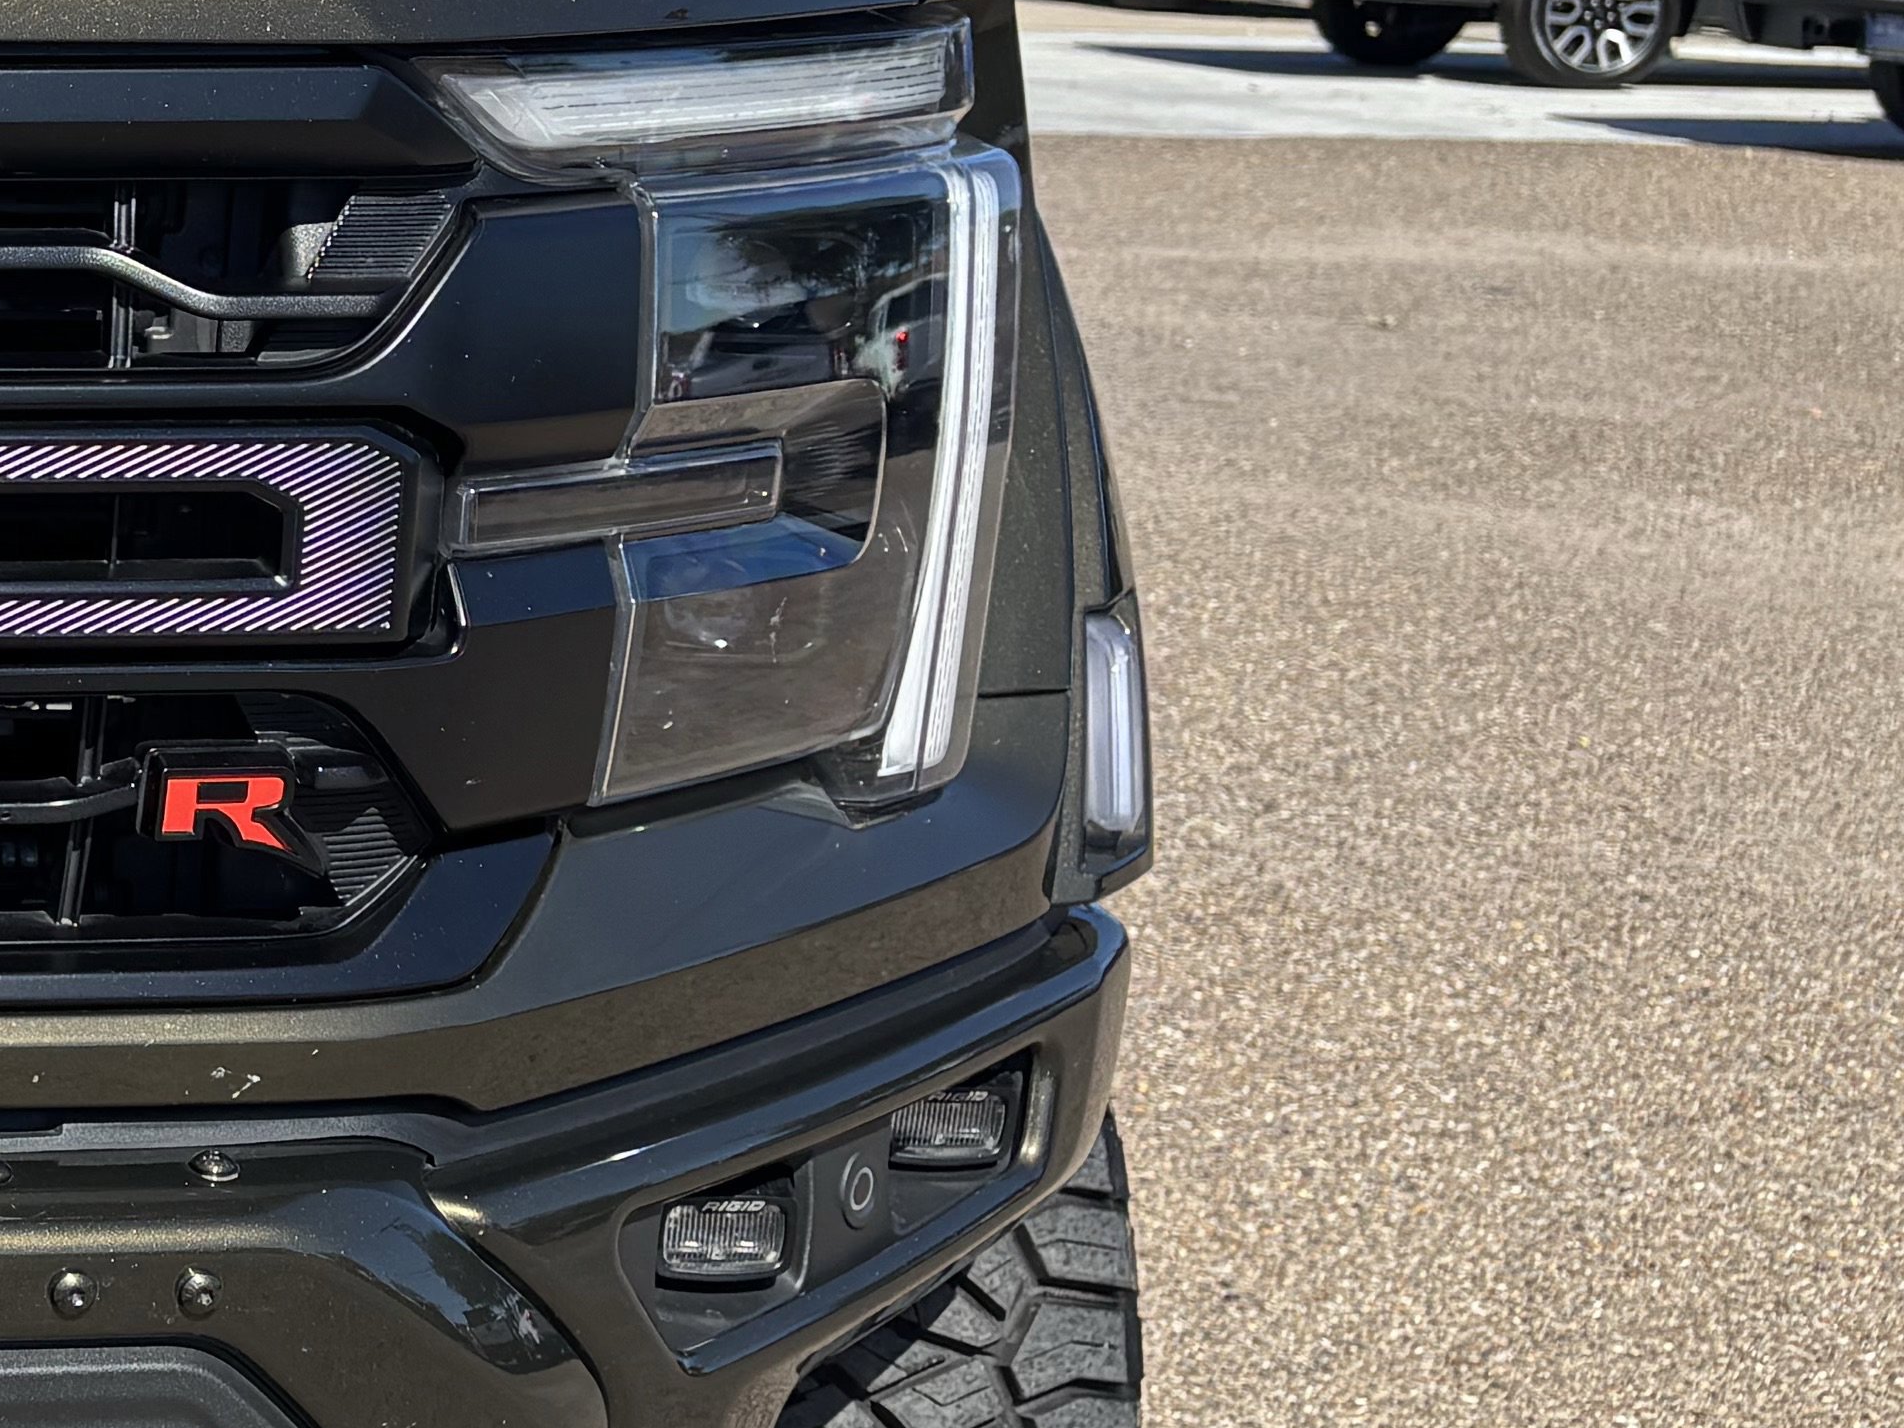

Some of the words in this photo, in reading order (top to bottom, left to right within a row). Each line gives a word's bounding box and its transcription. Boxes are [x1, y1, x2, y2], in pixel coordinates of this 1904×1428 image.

[154, 766, 298, 856] R
[928, 1091, 989, 1101] RIGID
[701, 1200, 766, 1212] RIGID
